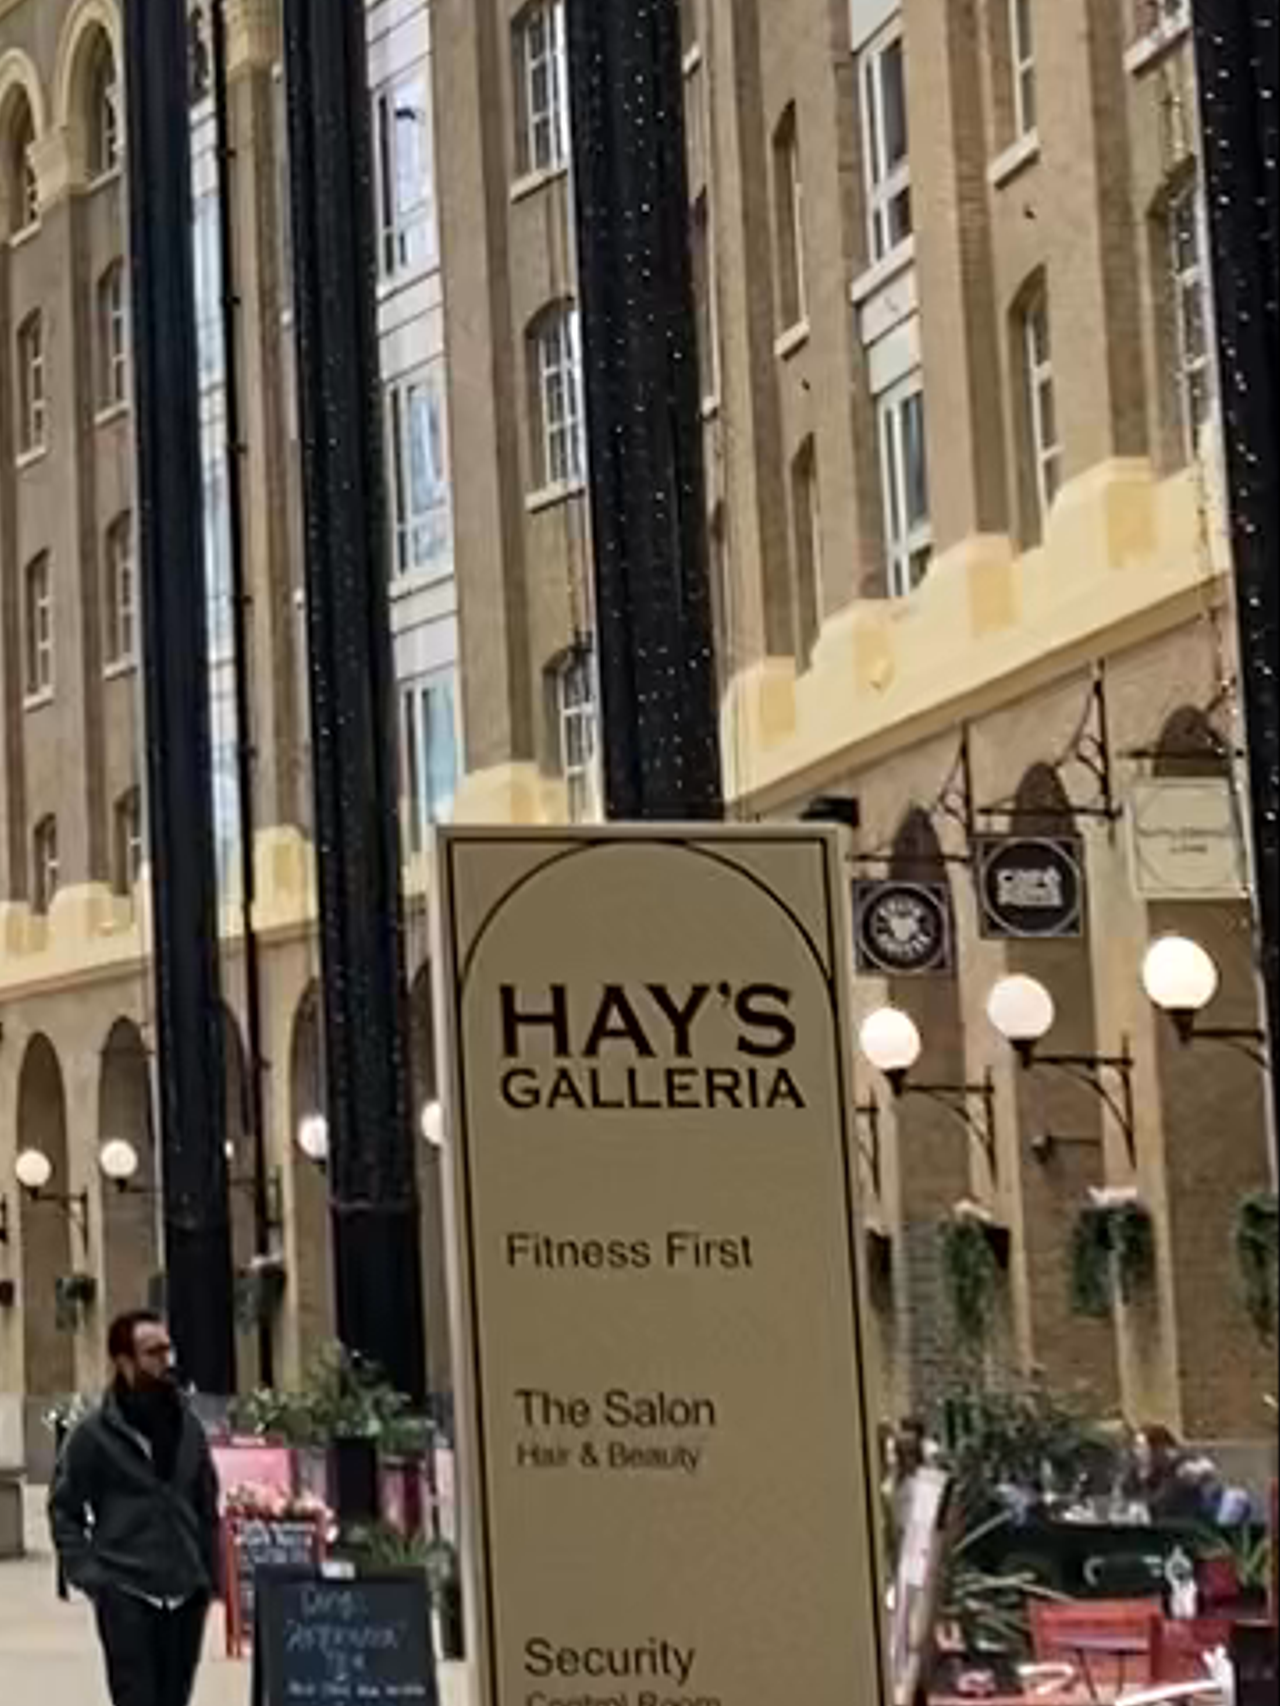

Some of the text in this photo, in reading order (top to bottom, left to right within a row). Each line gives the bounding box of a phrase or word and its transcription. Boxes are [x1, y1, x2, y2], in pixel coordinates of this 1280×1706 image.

[499, 981, 795, 1058] HAY'S
[501, 1067, 805, 1109] GALLERIA
[507, 1232, 752, 1268] Fitness First
[515, 1389, 715, 1428] The Salon
[518, 1442, 699, 1470] Hair & Beauty
[525, 1638, 694, 1686] Security
